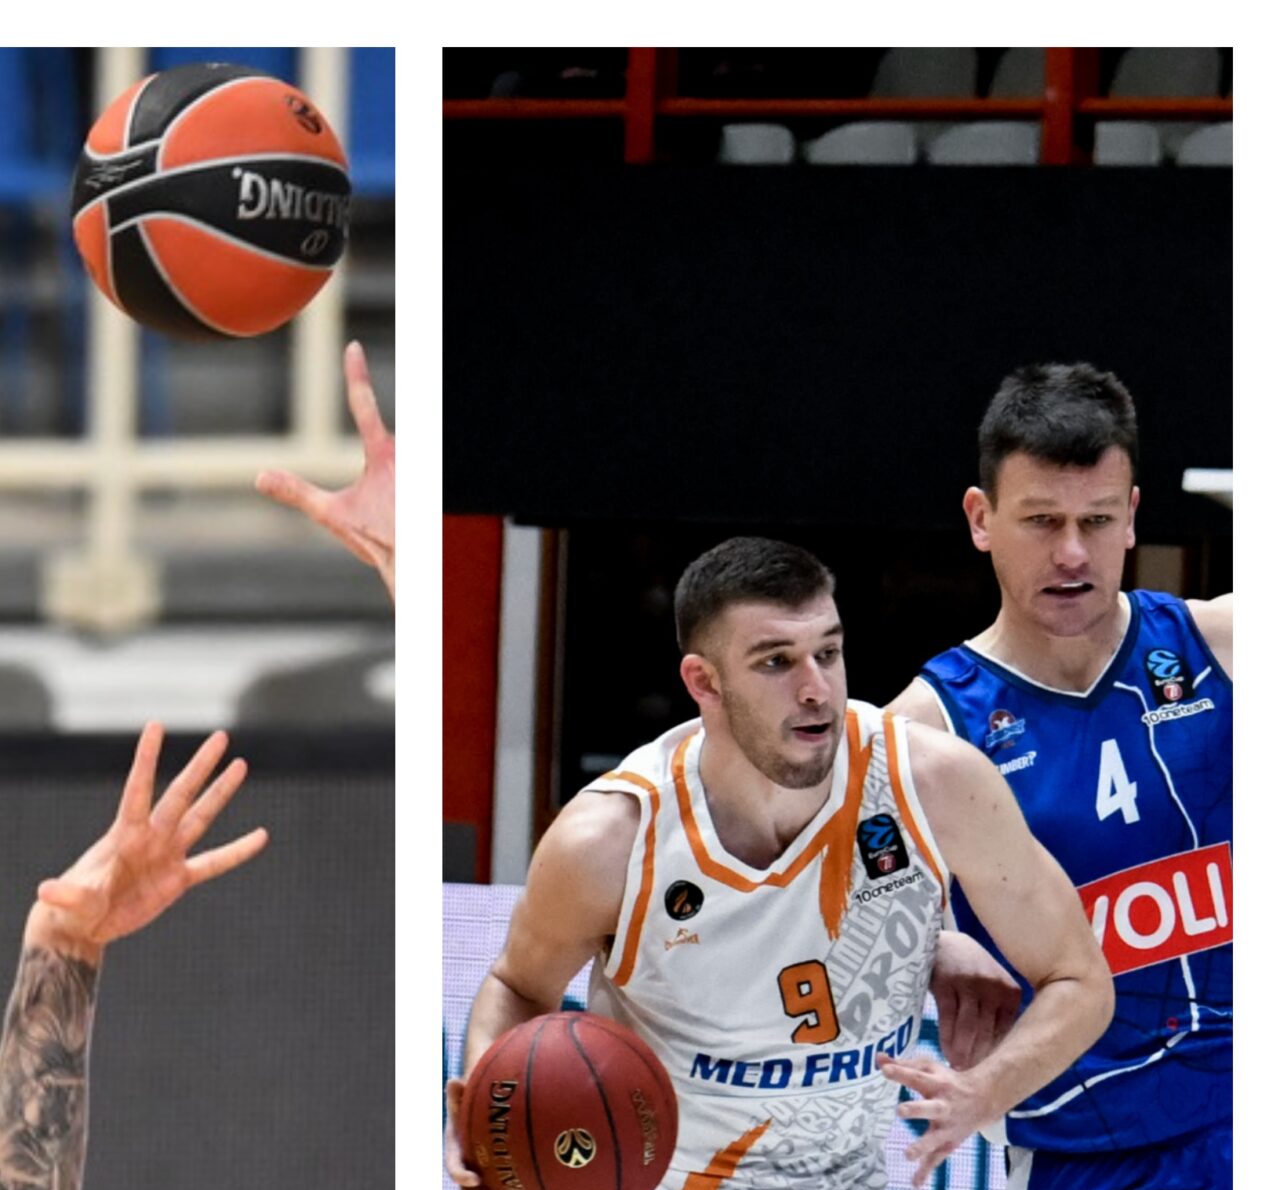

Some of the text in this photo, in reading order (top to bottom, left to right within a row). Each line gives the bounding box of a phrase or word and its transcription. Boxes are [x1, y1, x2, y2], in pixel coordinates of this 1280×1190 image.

[1095, 738, 1141, 825] 4
[777, 959, 841, 1045] 9
[689, 1052, 794, 1090] MED
